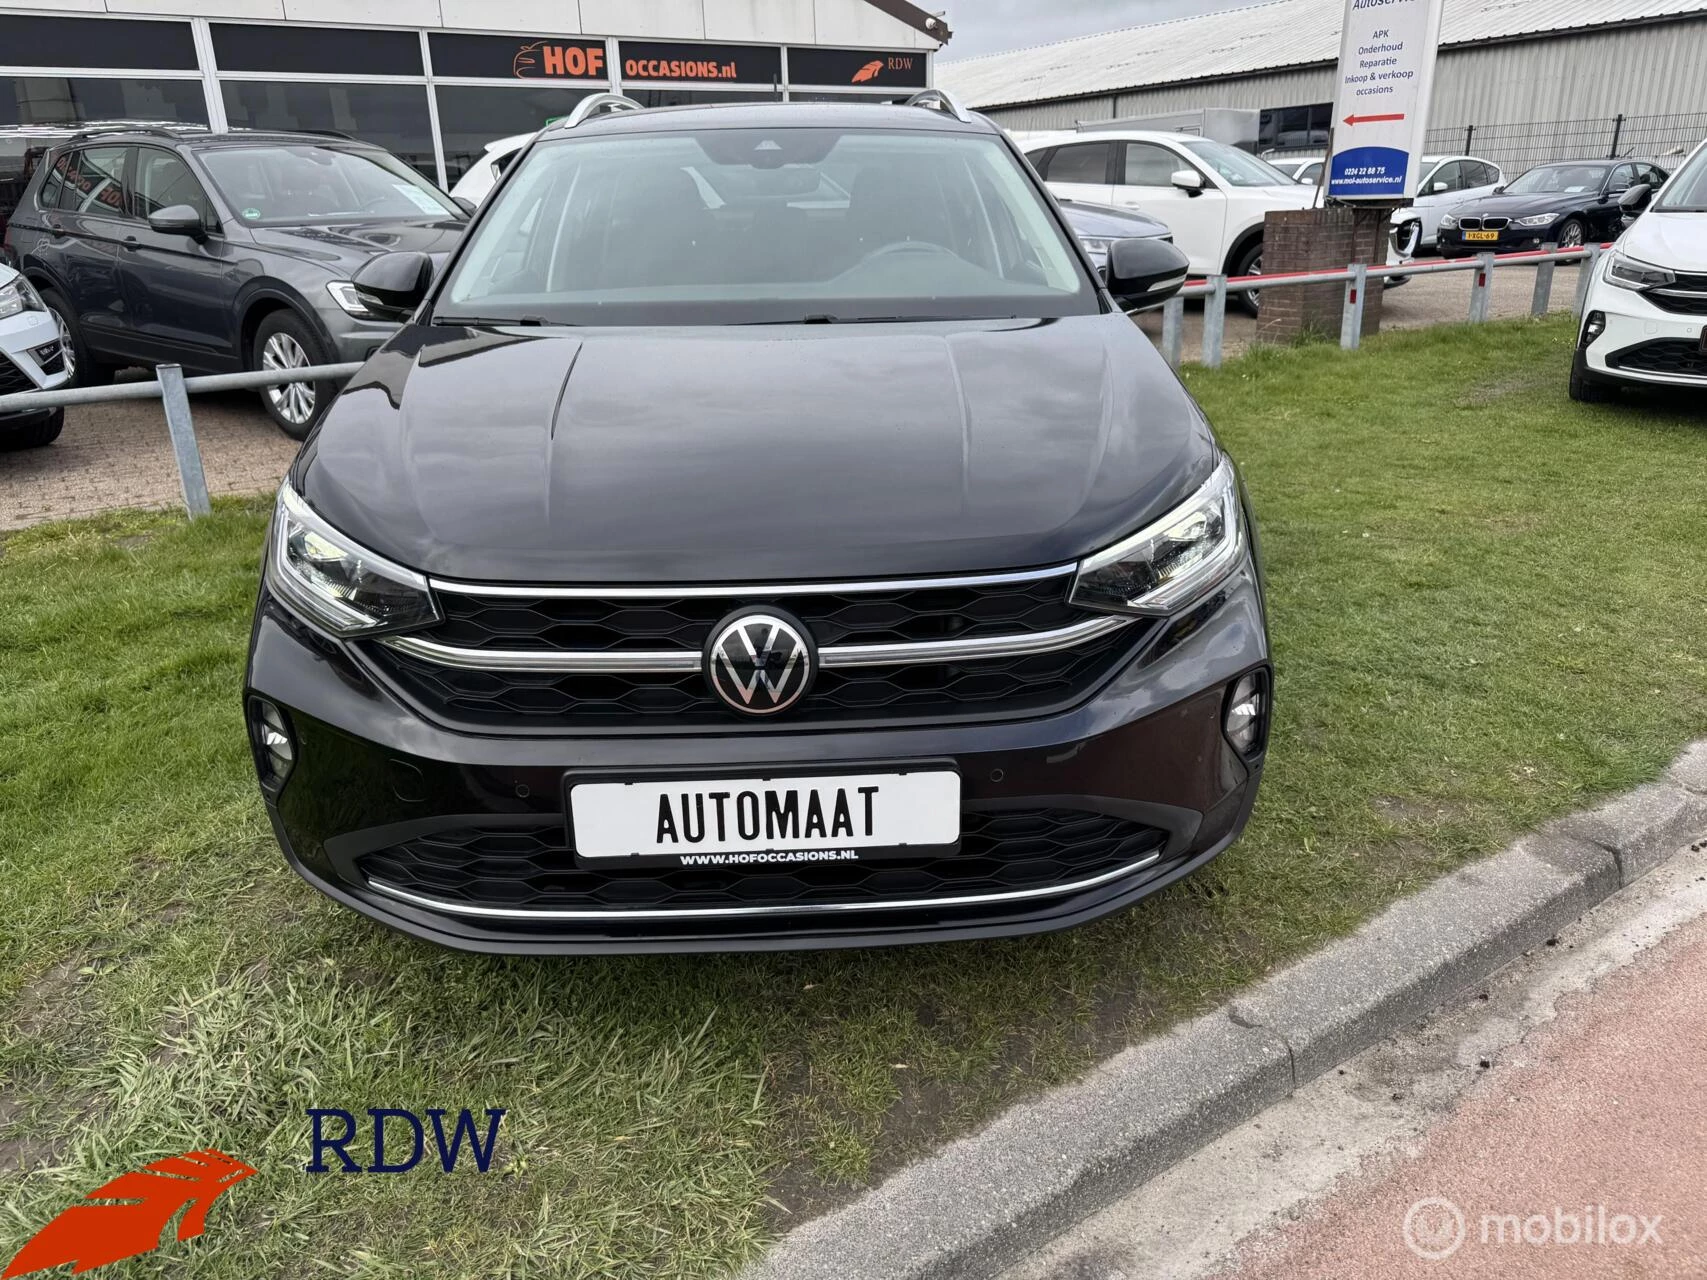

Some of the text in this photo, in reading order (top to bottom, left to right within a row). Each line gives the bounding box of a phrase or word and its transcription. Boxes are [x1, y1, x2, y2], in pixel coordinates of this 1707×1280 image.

[1372, 29, 1389, 39] APK
[1358, 41, 1404, 55] Onderhoud
[543, 46, 737, 78] HOF OCCASIONS.nl
[888, 57, 913, 70] RDW
[1360, 57, 1398, 69] Reparatie
[1344, 70, 1414, 84] Inkoop & verkoop
[1356, 85, 1394, 96] occasions
[1344, 167, 1358, 176] 0224
[1359, 167, 1367, 175] 22
[1376, 166, 1386, 174] 75
[1331, 175, 1403, 185] www.mol-autoservice.nl
[655, 786, 880, 845] AUTOMAAT
[680, 849, 860, 866] WWW.HOFOCCASIONS.NL
